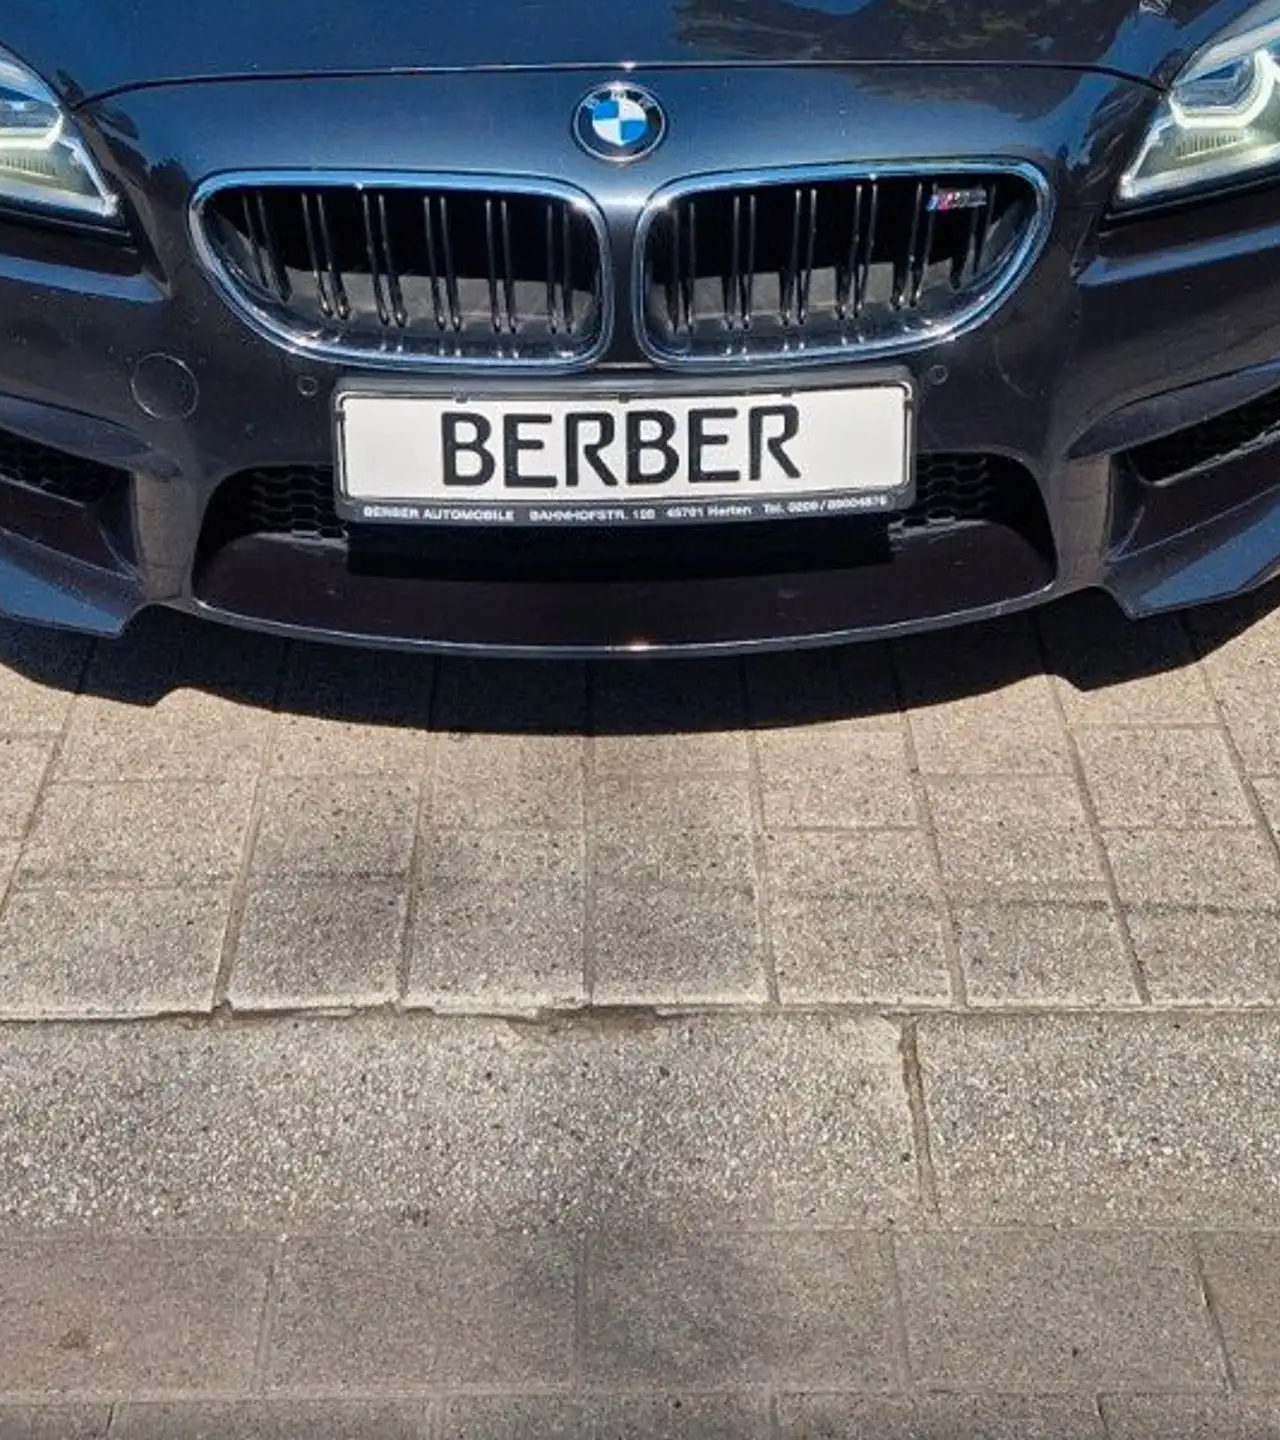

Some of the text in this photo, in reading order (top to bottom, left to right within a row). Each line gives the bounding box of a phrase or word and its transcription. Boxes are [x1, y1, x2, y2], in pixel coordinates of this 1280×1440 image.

[441, 403, 802, 489] BERBER
[363, 506, 419, 520] BERBER
[423, 508, 514, 522] AUTOMOBILE
